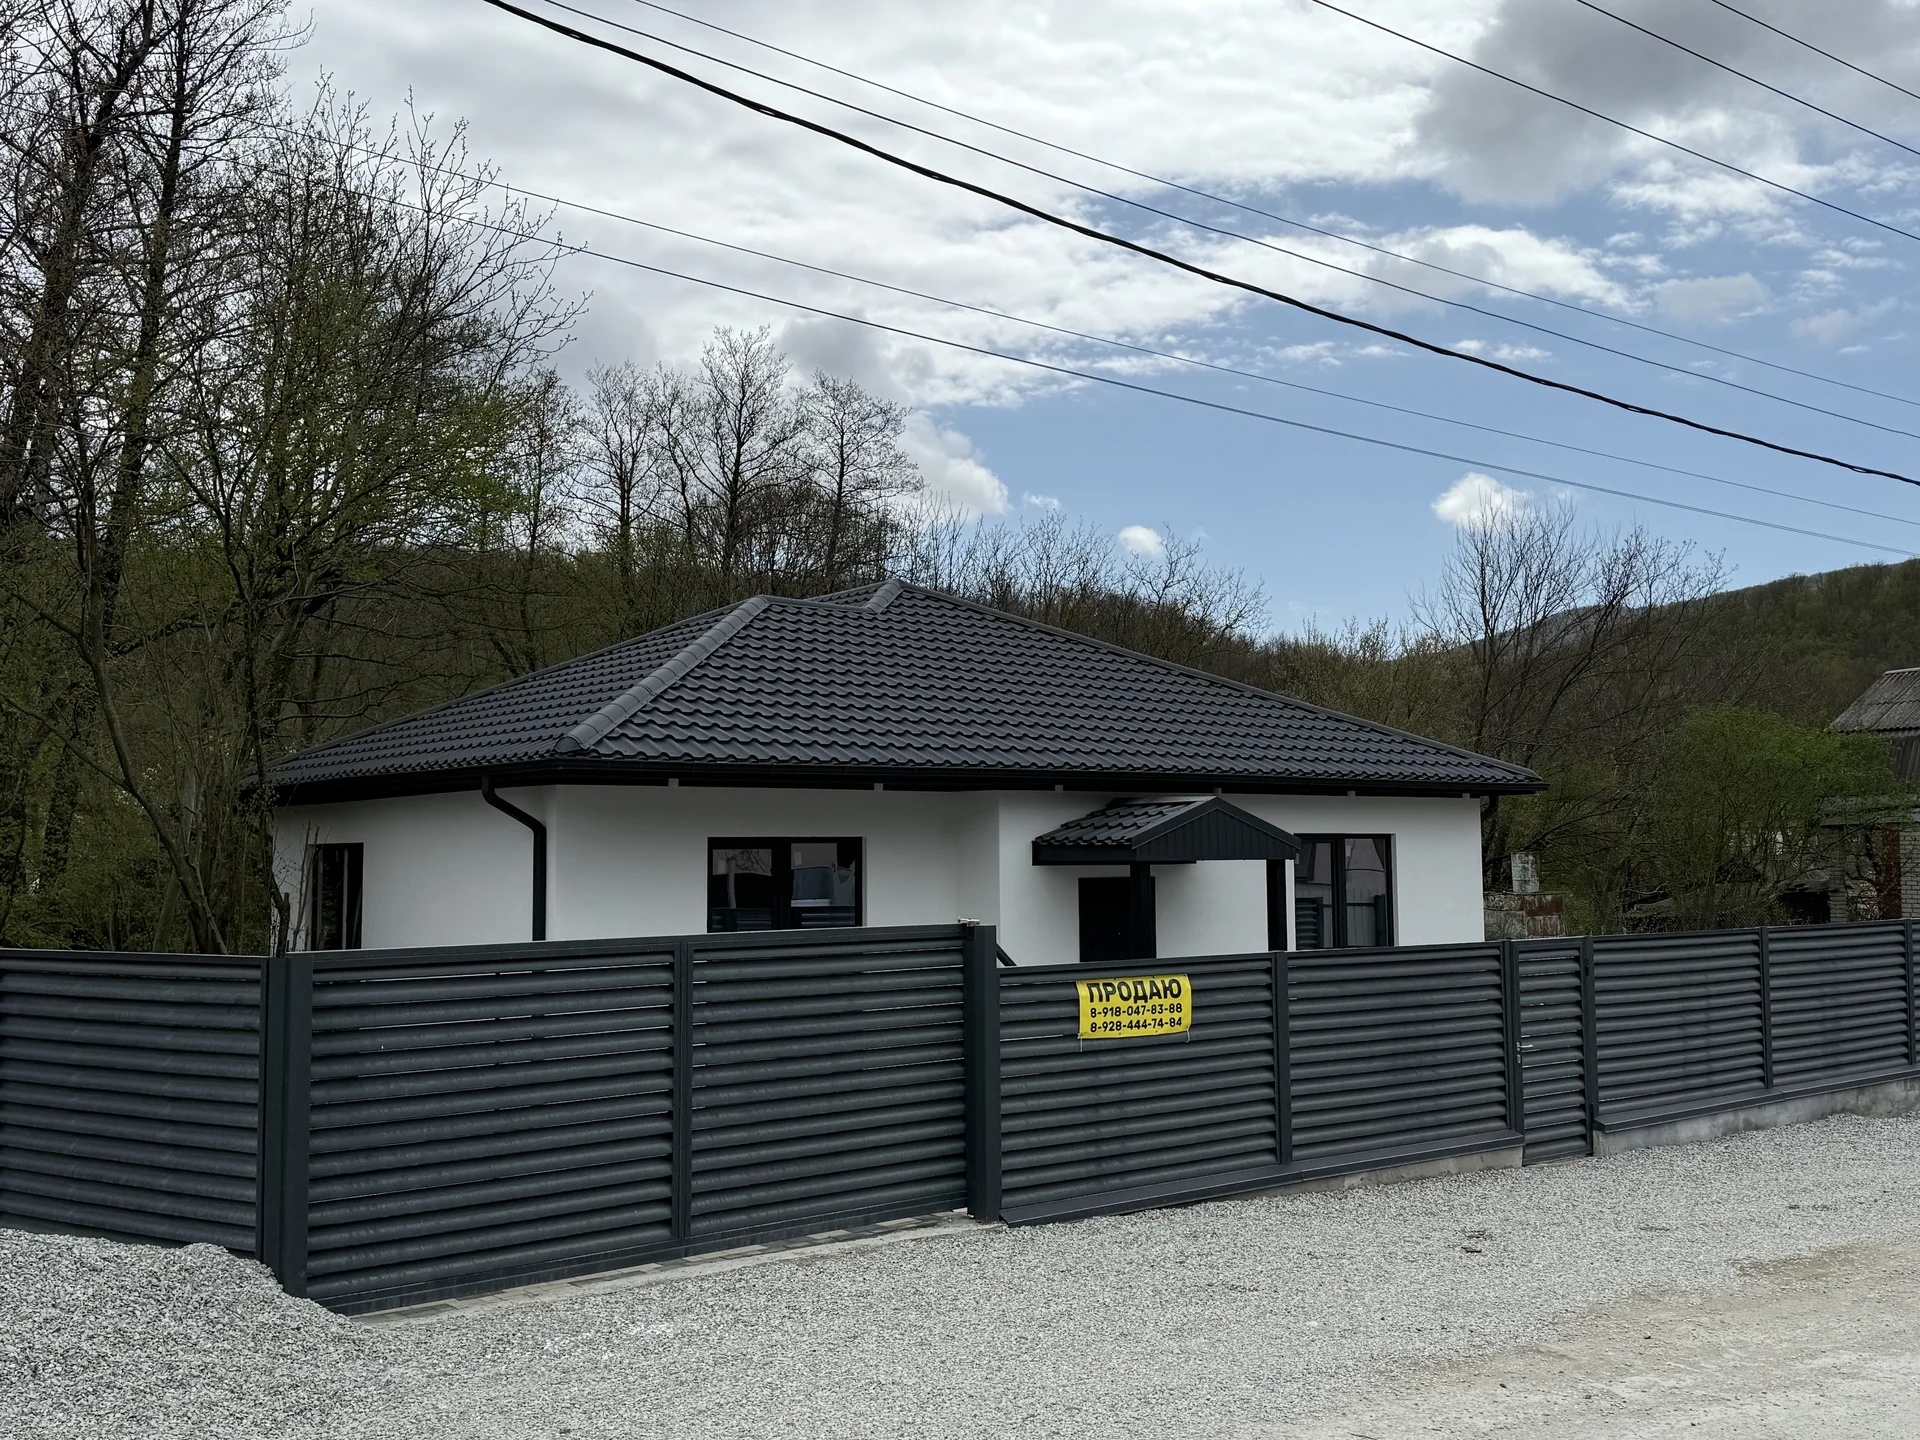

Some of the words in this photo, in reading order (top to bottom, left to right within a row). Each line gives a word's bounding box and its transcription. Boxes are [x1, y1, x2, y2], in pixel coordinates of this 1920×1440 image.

[1086, 979, 1182, 1004] ПРОДАЮ
[1090, 1003, 1183, 1018] 8-918-047-83-88
[1090, 1017, 1182, 1032] 8-928-444-74-84
